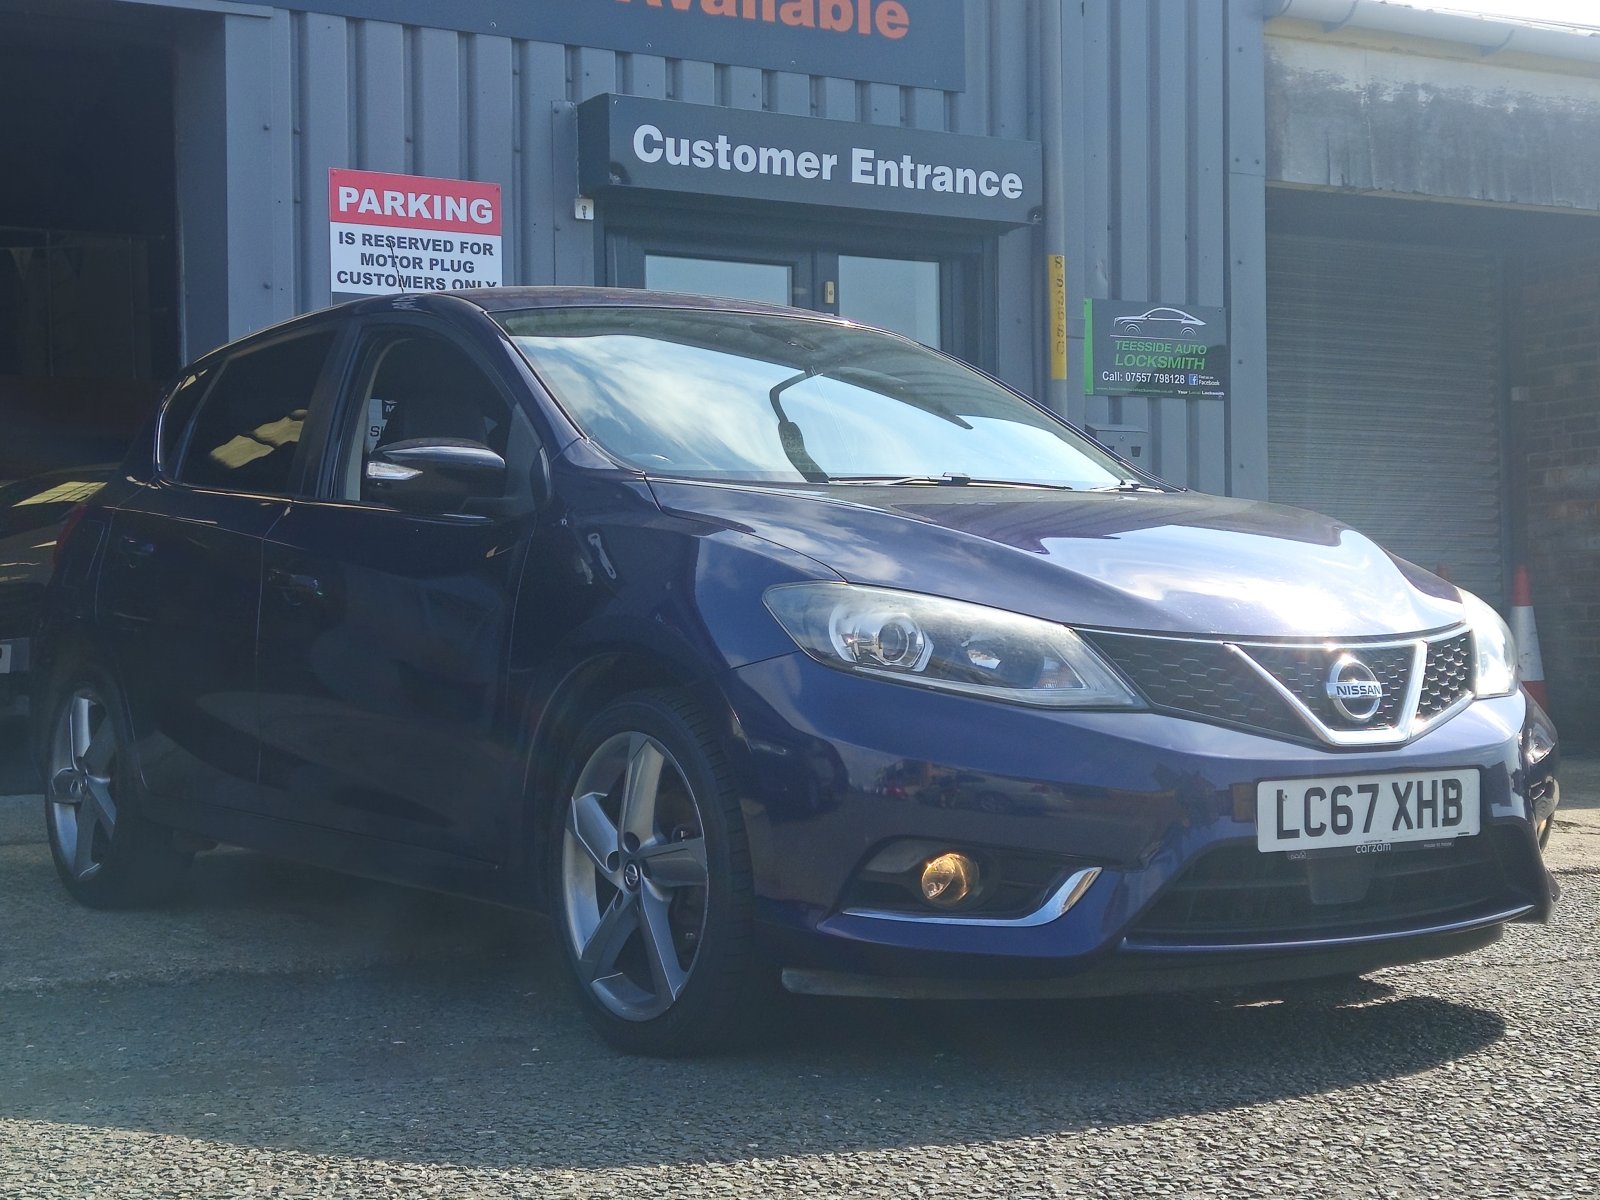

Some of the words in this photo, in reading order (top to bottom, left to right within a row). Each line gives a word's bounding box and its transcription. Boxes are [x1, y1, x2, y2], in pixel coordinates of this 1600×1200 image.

[616, 0, 911, 40] lable
[632, 123, 838, 181] Customer
[851, 147, 1024, 200] Entrance
[338, 186, 493, 225] PARKING
[338, 231, 356, 245] IS
[361, 233, 454, 253] RESERVED
[460, 241, 494, 256] FOR
[360, 252, 424, 270] MOTOR
[429, 258, 475, 274] PLUG
[336, 270, 447, 291] CUSTOMERS
[1115, 340, 1172, 353] TEESSIDE
[1175, 343, 1207, 355] AUTO
[1115, 354, 1206, 370] LOCKSMITH
[1102, 371, 1123, 382] Call:
[1125, 372, 1152, 383] 07557
[1153, 373, 1185, 384] 798128
[1336, 685, 1381, 696] NISSAN
[1276, 783, 1380, 841] LC67
[1391, 778, 1463, 832] XHB
[1355, 843, 1392, 854] carzam
